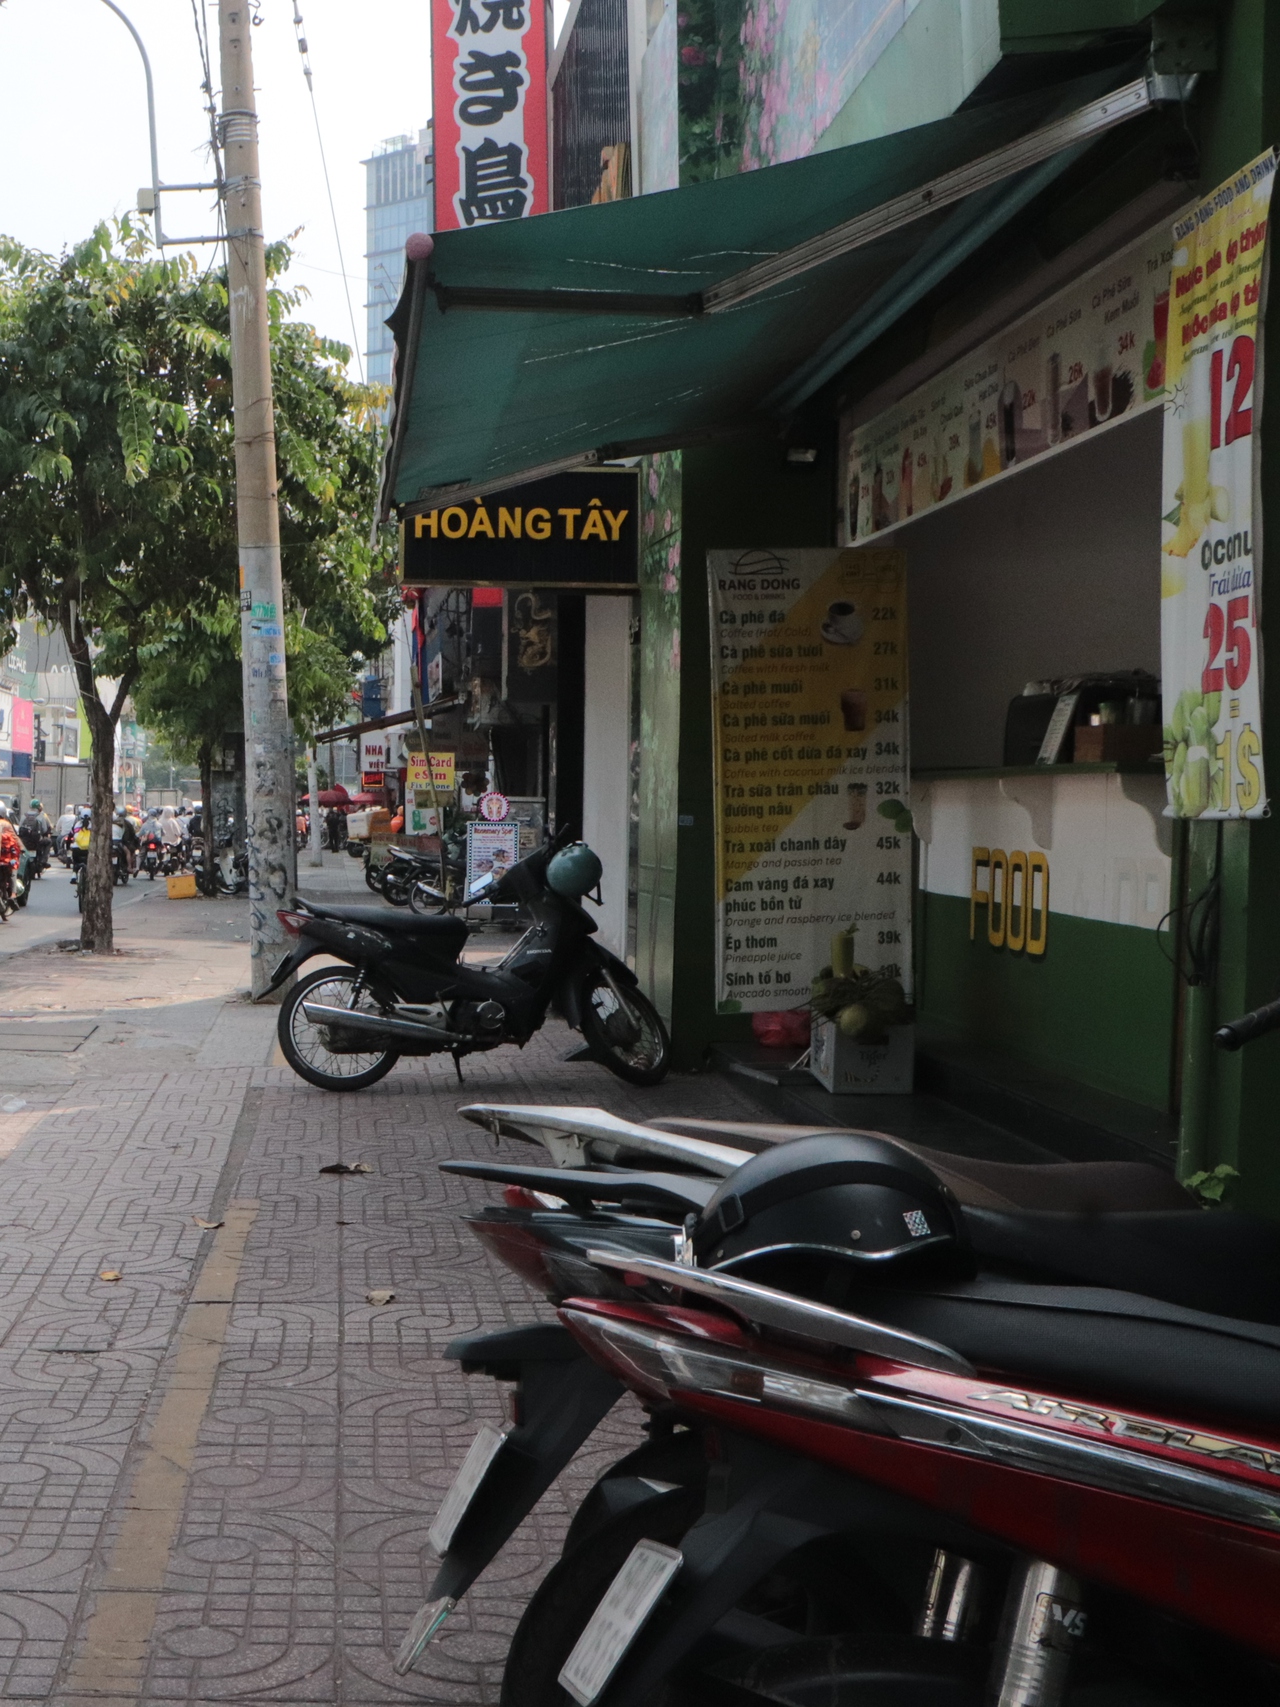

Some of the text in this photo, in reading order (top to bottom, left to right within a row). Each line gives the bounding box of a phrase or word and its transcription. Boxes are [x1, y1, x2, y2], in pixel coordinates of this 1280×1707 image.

[1211, 335, 1255, 450] 12
[414, 497, 629, 541] HOÀNG TÂY
[719, 578, 800, 591] RANG DONG
[720, 609, 785, 626] Cà phê đá
[872, 607, 897, 620] 22k
[721, 628, 752, 638] Coffee
[720, 645, 737, 659] Cà
[742, 645, 766, 662] phê
[770, 643, 793, 658] sữa
[874, 642, 898, 655] 27k
[721, 664, 753, 674] Coffee
[756, 664, 778, 674] with
[780, 664, 807, 673] fresh
[722, 679, 803, 698] Cà phê muối
[874, 678, 898, 690] 31k
[722, 700, 790, 709] Salted coffee
[723, 710, 830, 729] Cà phê sữa muối
[875, 710, 899, 723] 34k
[725, 733, 758, 742] Salted
[783, 733, 815, 741] coffee
[365, 745, 382, 755] NHA
[724, 745, 867, 764] Cà phê cốt dừa đá xay
[875, 742, 899, 755] 34k
[411, 756, 452, 767] Sim Card
[724, 769, 756, 779] Coffee
[724, 782, 838, 798] Trà sữa trân châu
[876, 781, 900, 795] 32k
[725, 802, 792, 819] đường nâu
[725, 822, 778, 834] Bubble tea
[725, 836, 847, 853] Trà xoài chanh dây
[876, 836, 901, 850] 45k
[725, 857, 842, 871] Mango and passion tea
[725, 875, 835, 893] Cam vàng đá xay
[876, 872, 901, 884] 44k
[725, 895, 802, 916] phúc bồn tử
[970, 847, 1048, 955] FOOD
[725, 917, 761, 928] Orange
[764, 915, 783, 924] and
[837, 912, 852, 921] ice
[725, 932, 777, 950] Ép thơm
[878, 931, 901, 944] 39k
[725, 952, 802, 964] Pineapple juice
[726, 968, 791, 986] Sinh tố bơ
[774, 987, 811, 996] smooth
[966, 1391, 1280, 1474] AIRBLA
